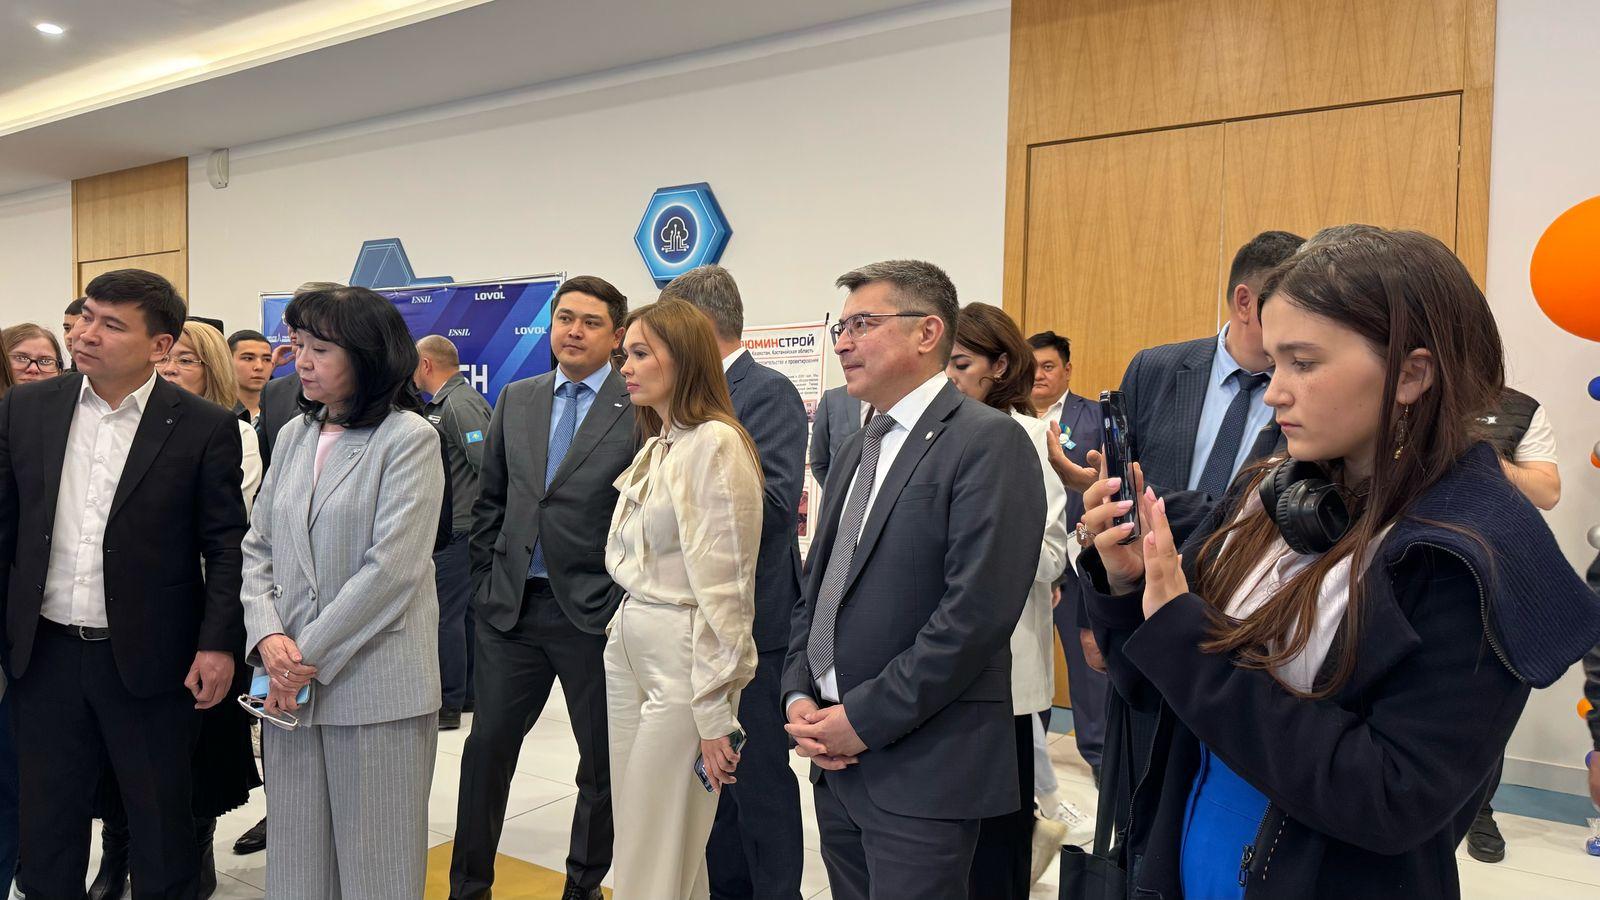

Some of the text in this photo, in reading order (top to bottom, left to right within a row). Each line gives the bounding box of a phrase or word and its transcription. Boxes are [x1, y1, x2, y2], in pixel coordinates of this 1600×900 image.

[474, 291, 505, 300] LOVOL
[411, 296, 433, 304] ESSIL
[448, 328, 471, 336] ESSIL
[514, 326, 547, 335] LOVOL
